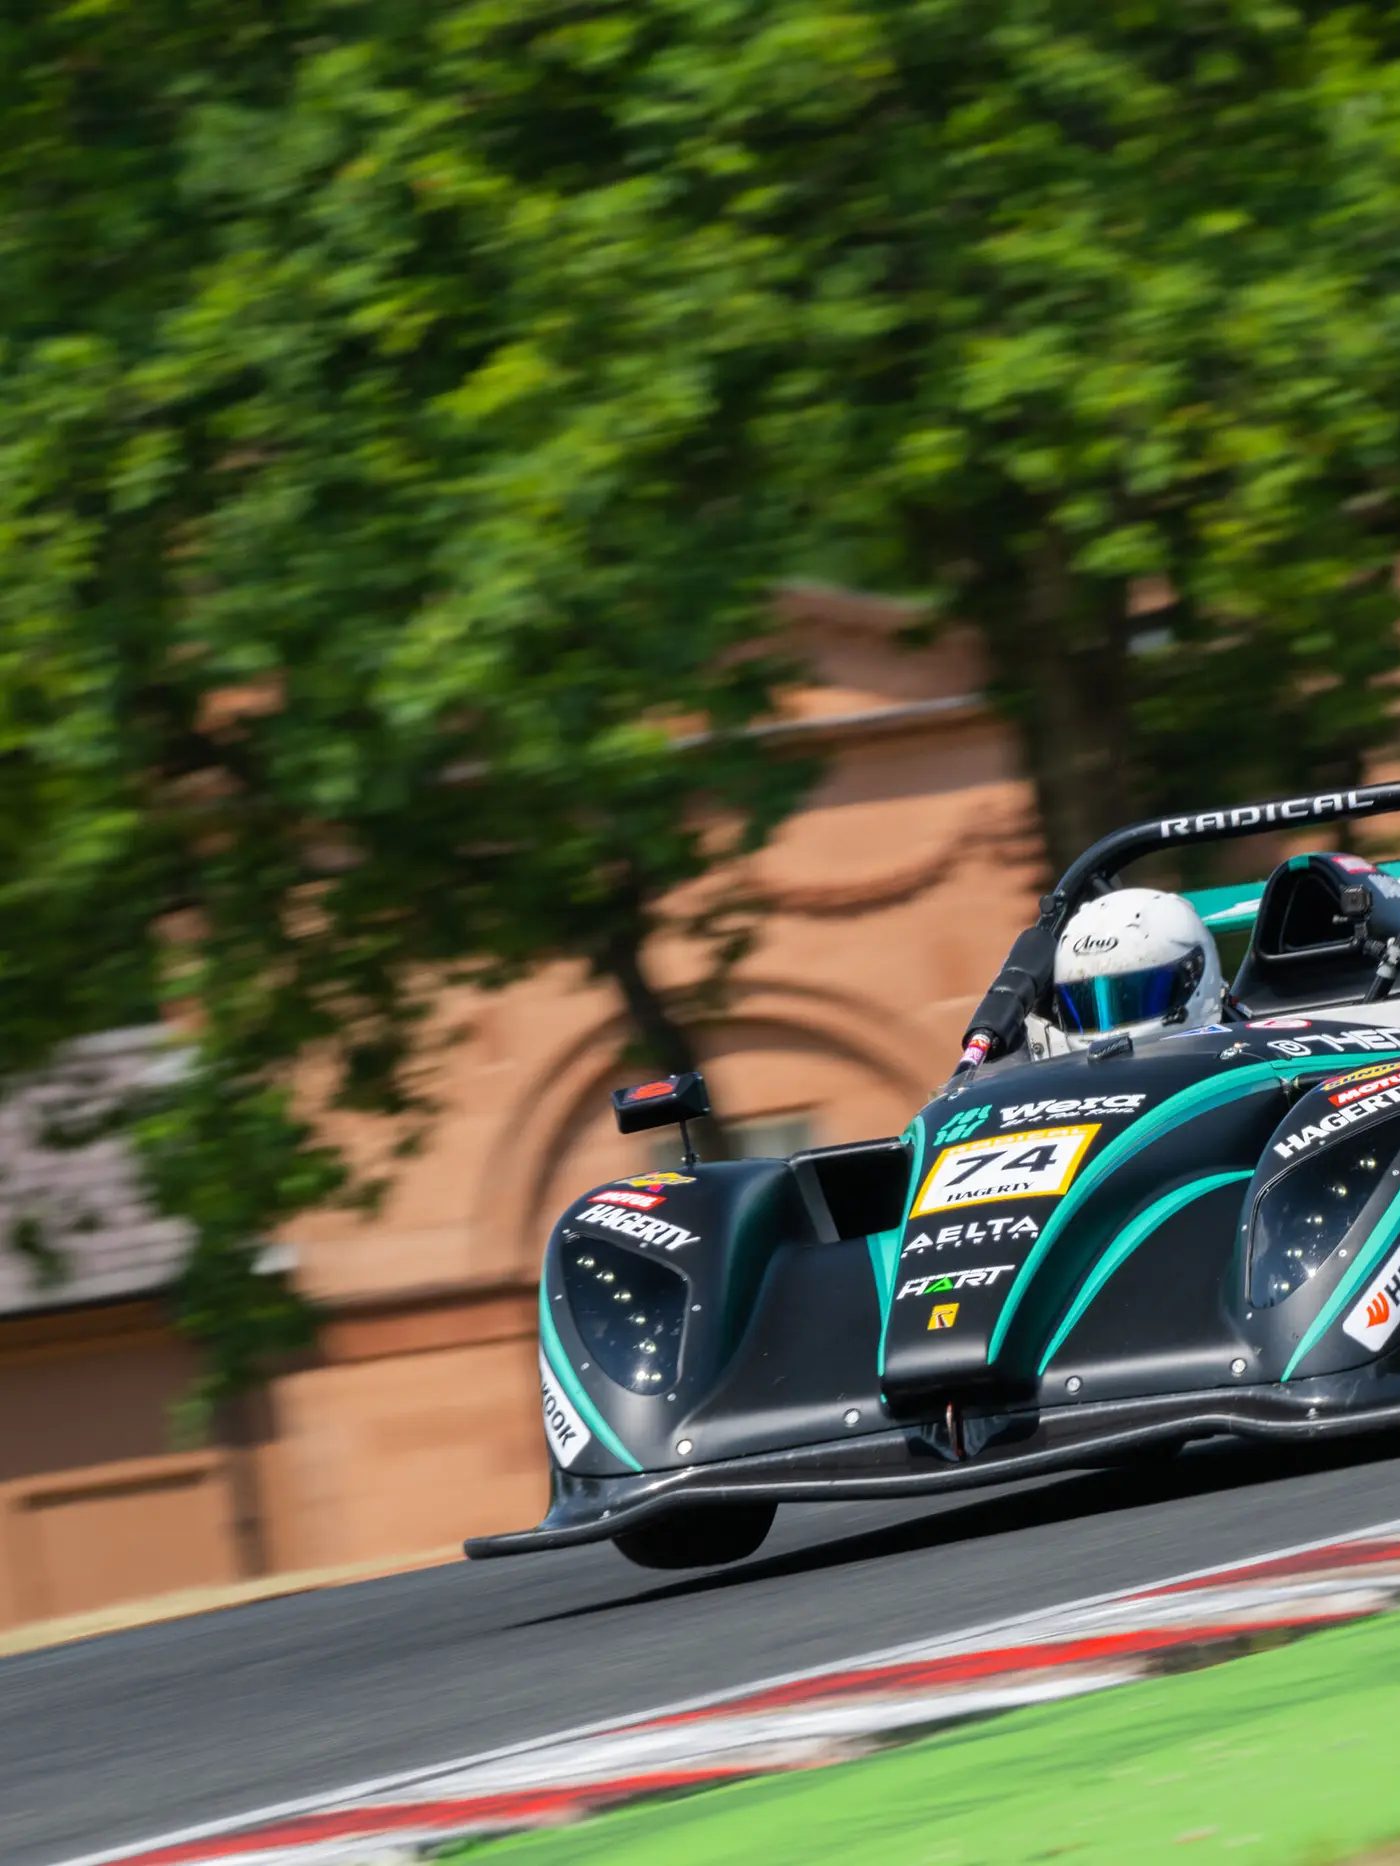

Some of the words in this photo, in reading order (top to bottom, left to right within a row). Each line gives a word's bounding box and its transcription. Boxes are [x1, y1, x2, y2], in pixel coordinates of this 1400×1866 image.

[1161, 791, 1374, 837] RADICAL
[1000, 1094, 1146, 1122] Wera
[944, 1144, 1058, 1188] 74
[946, 1181, 1035, 1203] HAGERTY
[575, 1203, 701, 1251] HAGERTY
